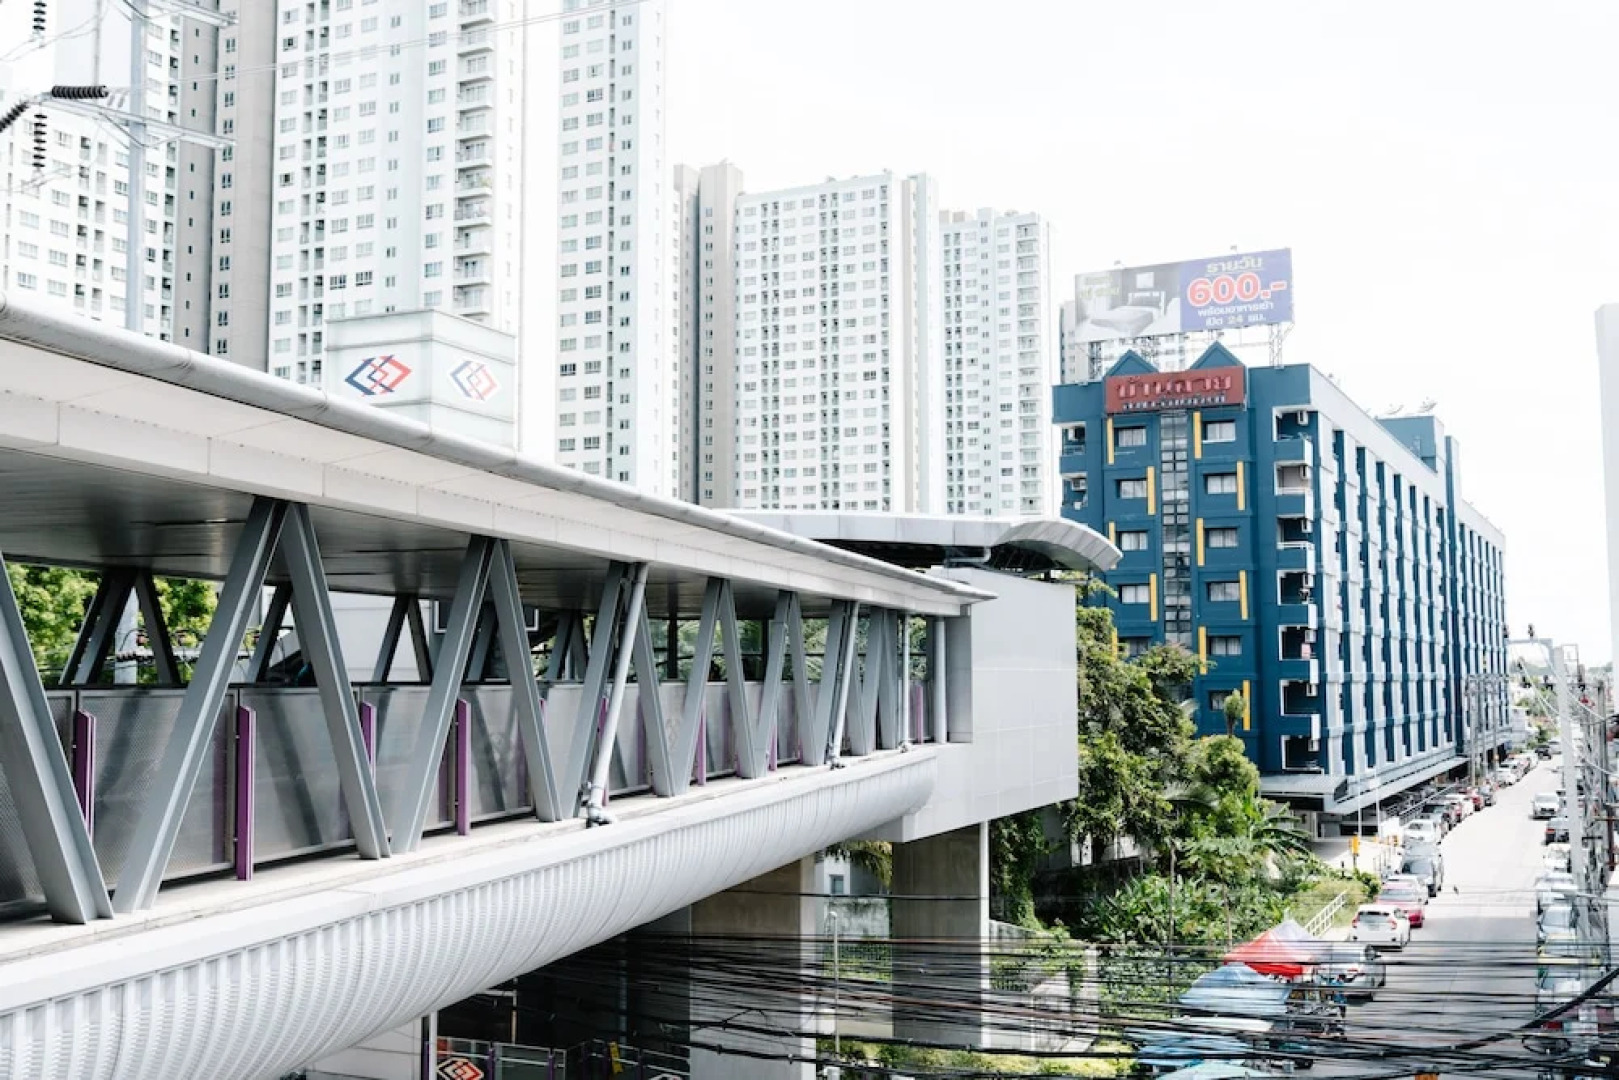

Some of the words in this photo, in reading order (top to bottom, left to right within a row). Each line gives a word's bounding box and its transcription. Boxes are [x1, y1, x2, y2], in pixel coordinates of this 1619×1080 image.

[1206, 256, 1263, 273] รายวัน
[1187, 271, 1288, 307] 600.-
[1228, 315, 1243, 325] 24
